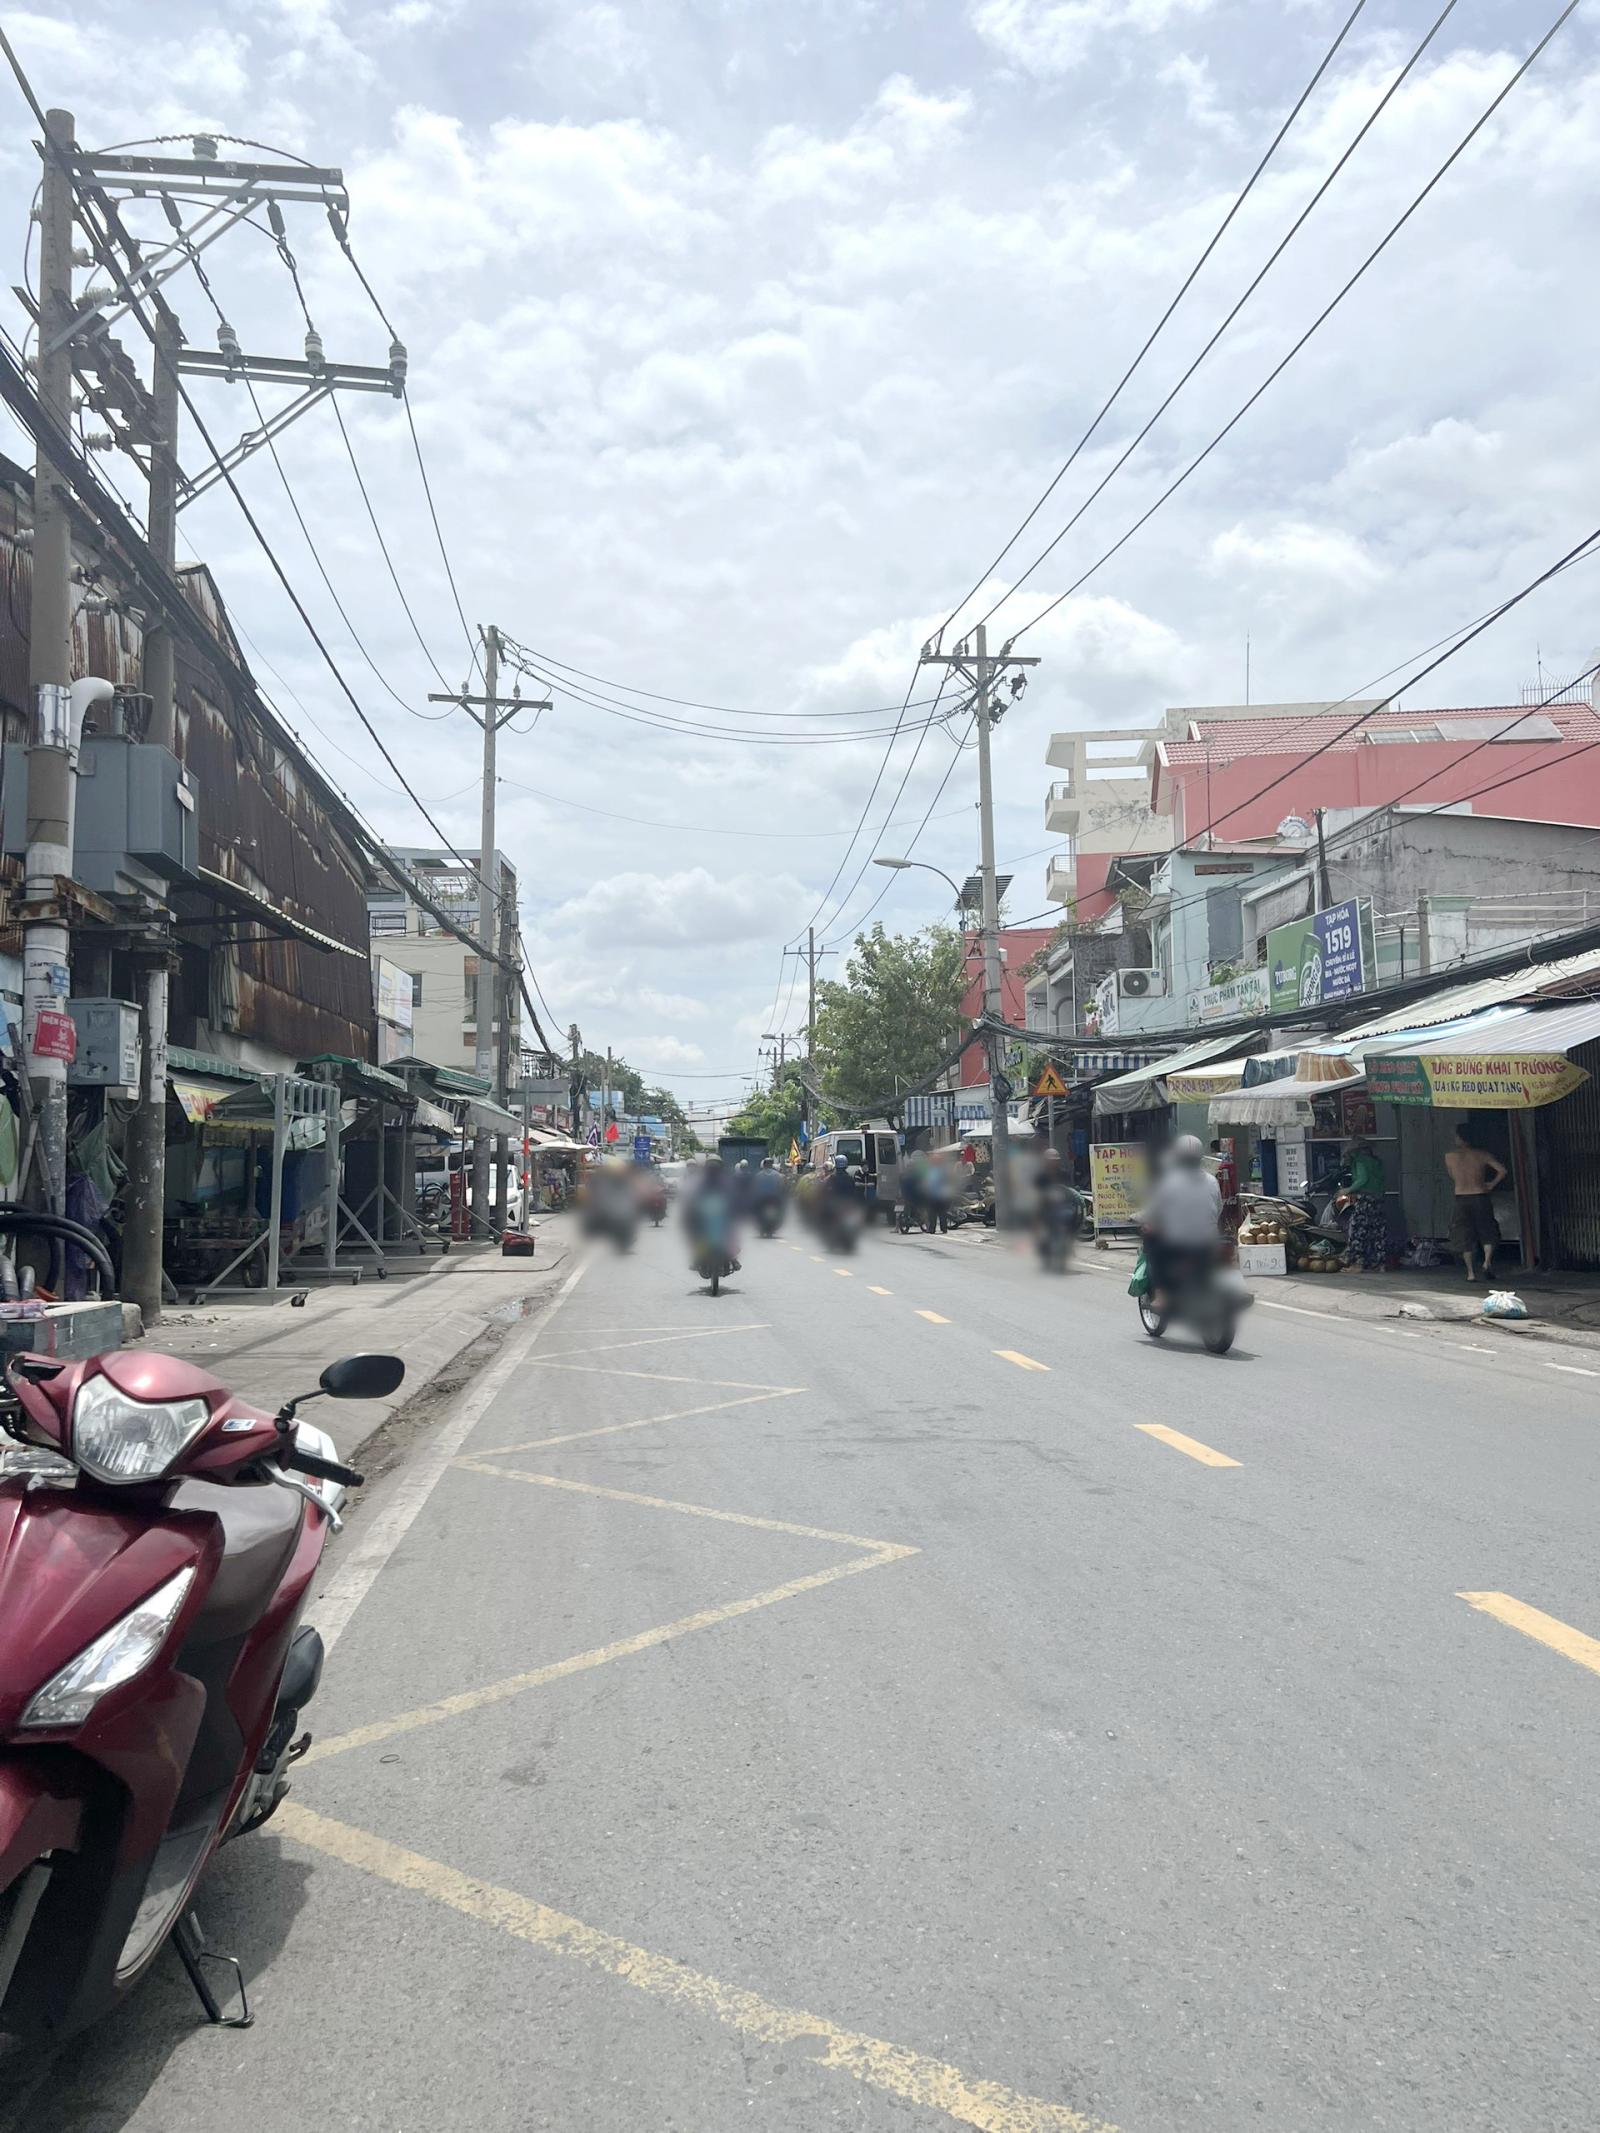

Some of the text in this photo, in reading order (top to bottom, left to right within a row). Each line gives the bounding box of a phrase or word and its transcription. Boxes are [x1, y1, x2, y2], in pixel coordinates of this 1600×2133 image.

[1325, 912, 1337, 928] TẠP
[1325, 925, 1352, 954] 1519
[1486, 1061, 1511, 1075] KHAI
[1462, 1080, 1476, 1093] HEO
[1477, 1080, 1499, 1094] QUAY
